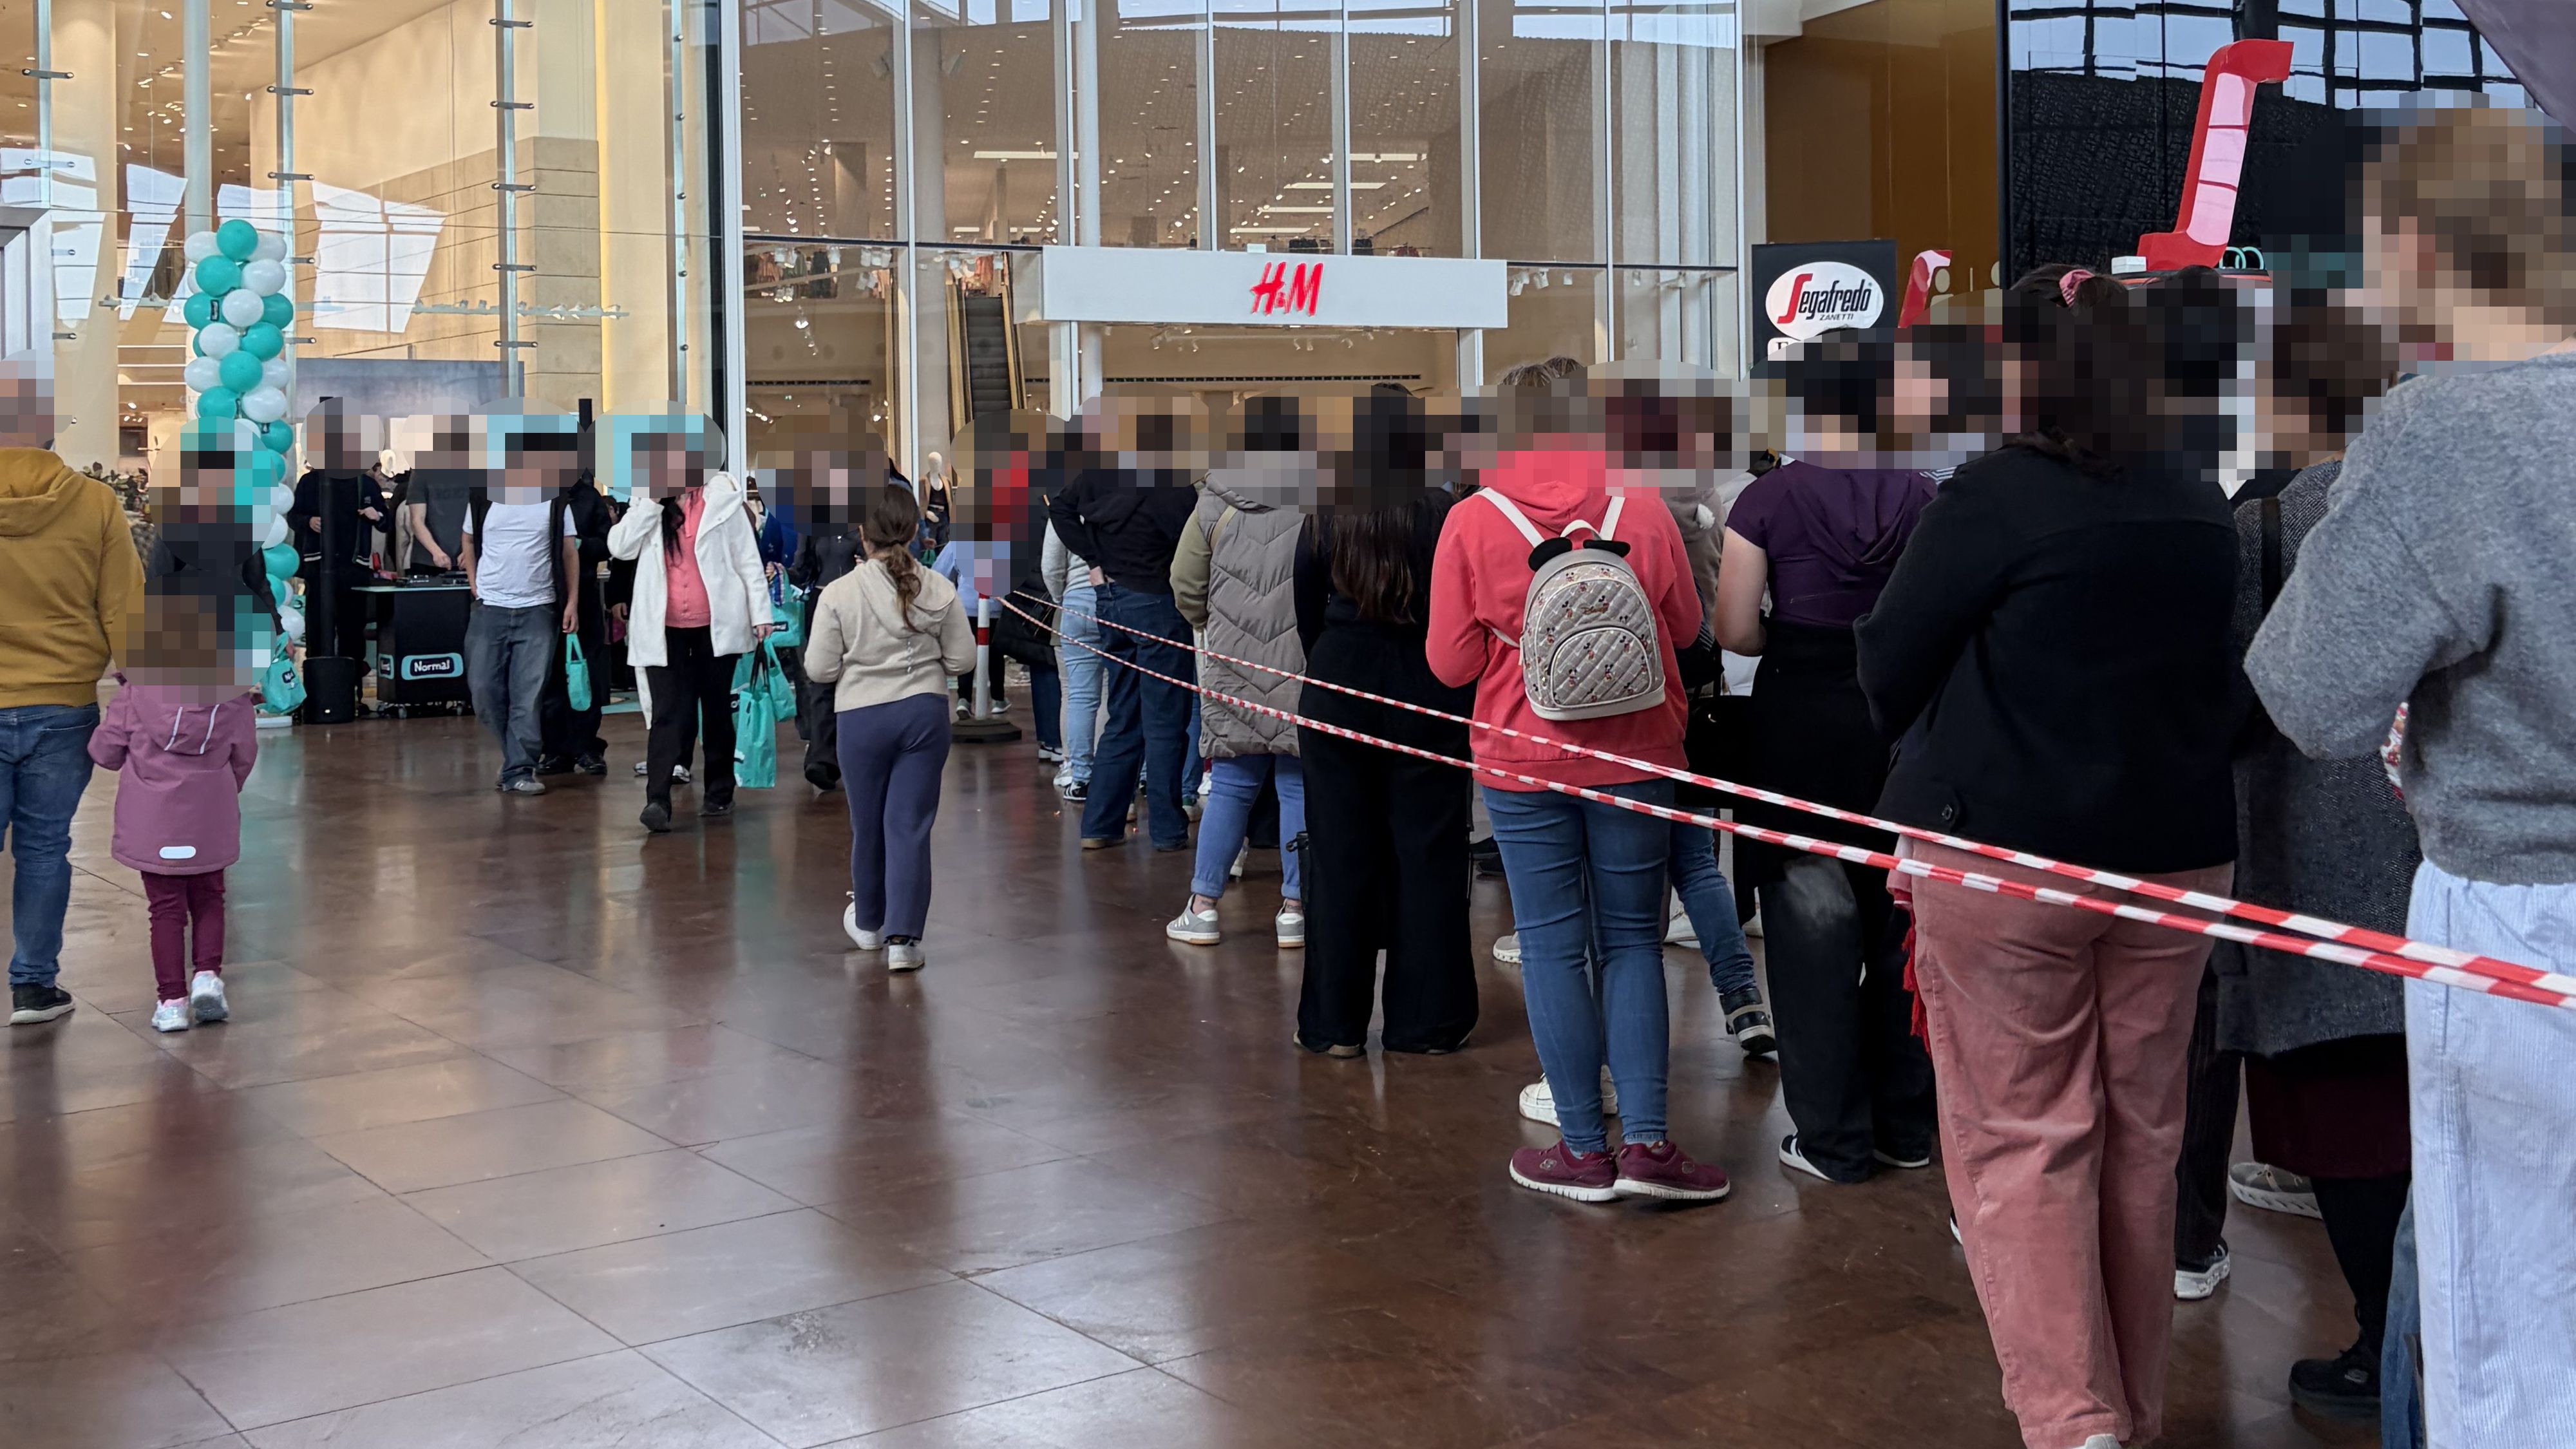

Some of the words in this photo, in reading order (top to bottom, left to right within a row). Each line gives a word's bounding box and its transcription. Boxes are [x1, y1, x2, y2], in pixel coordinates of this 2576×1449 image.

[1250, 261, 1323, 316] H&M
[1777, 273, 1871, 323] Segafredo
[413, 659, 450, 672] Normal
